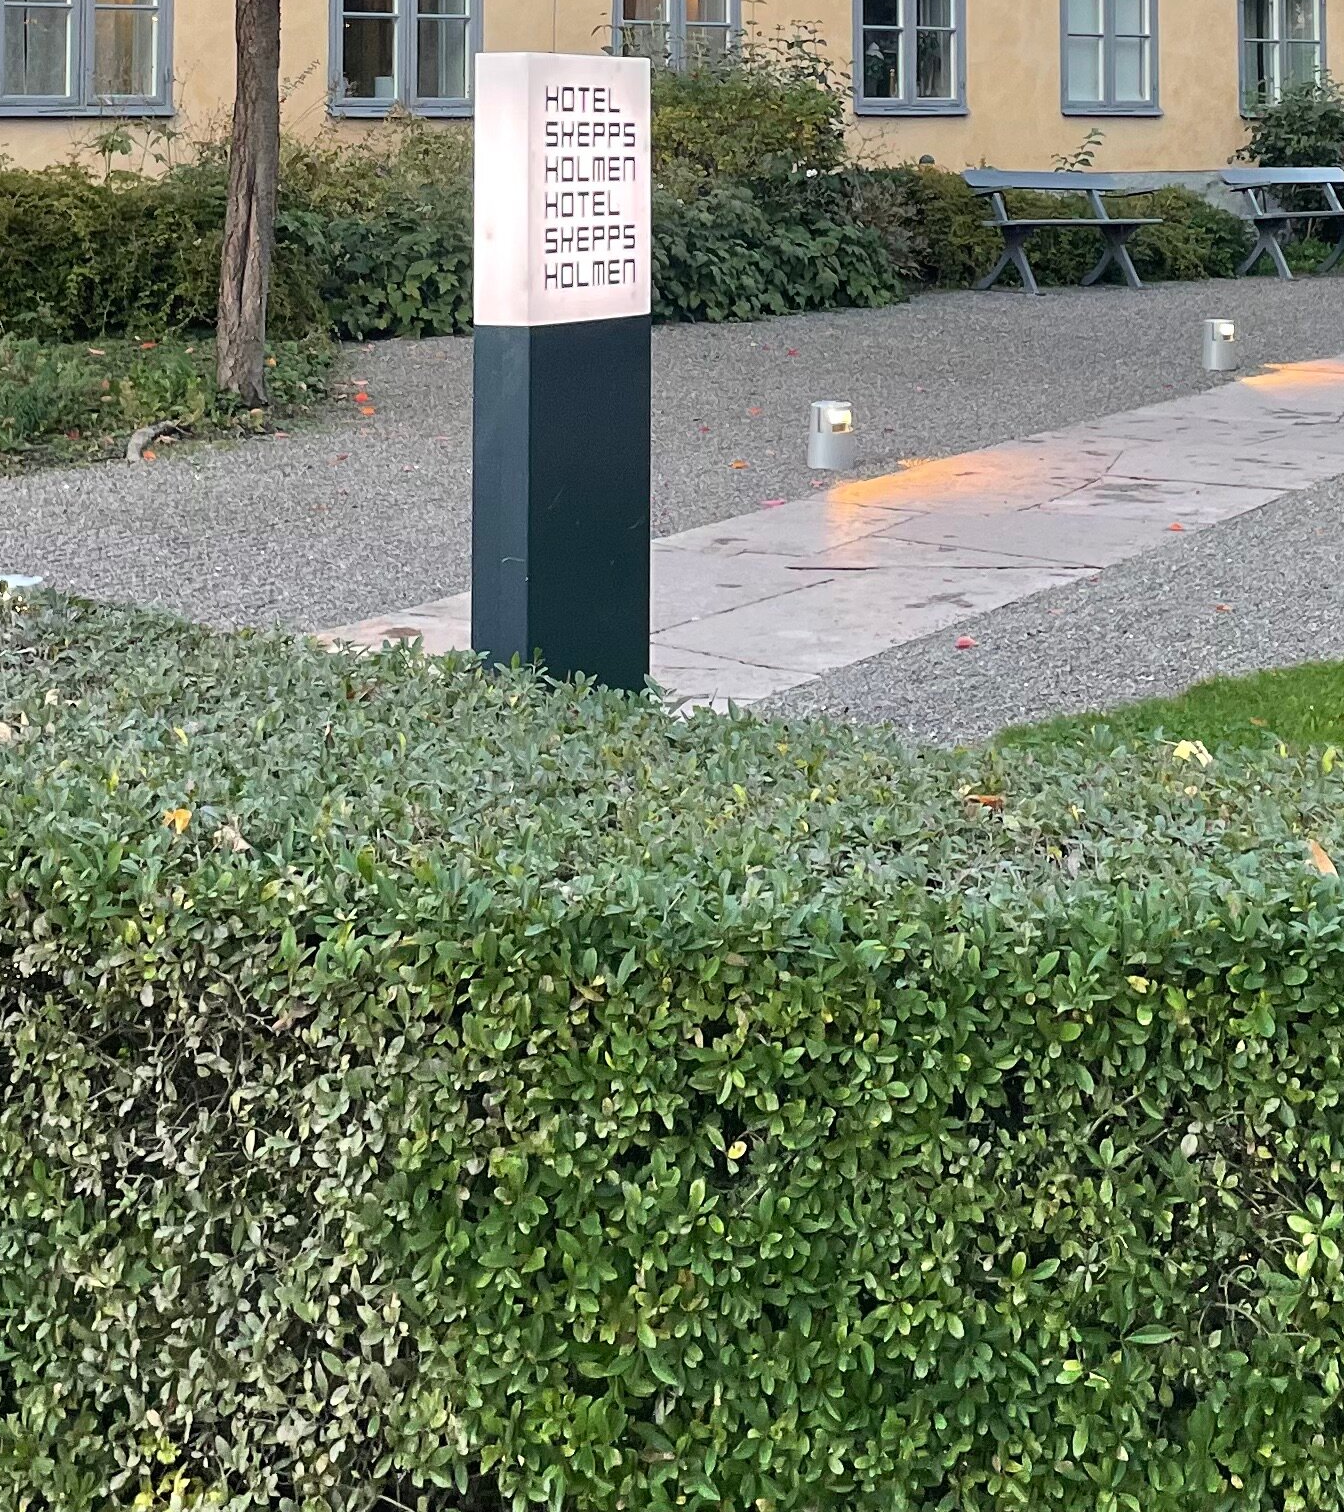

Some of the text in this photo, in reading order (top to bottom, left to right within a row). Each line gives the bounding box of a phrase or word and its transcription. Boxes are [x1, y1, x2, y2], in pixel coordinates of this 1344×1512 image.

[545, 86, 620, 113] HOTEL
[545, 121, 636, 148] SKEPPS
[545, 156, 636, 183] HOLMEN
[545, 191, 620, 218] HOTEL
[545, 224, 636, 254] SKEPPS
[545, 258, 636, 290] HOLMEN
